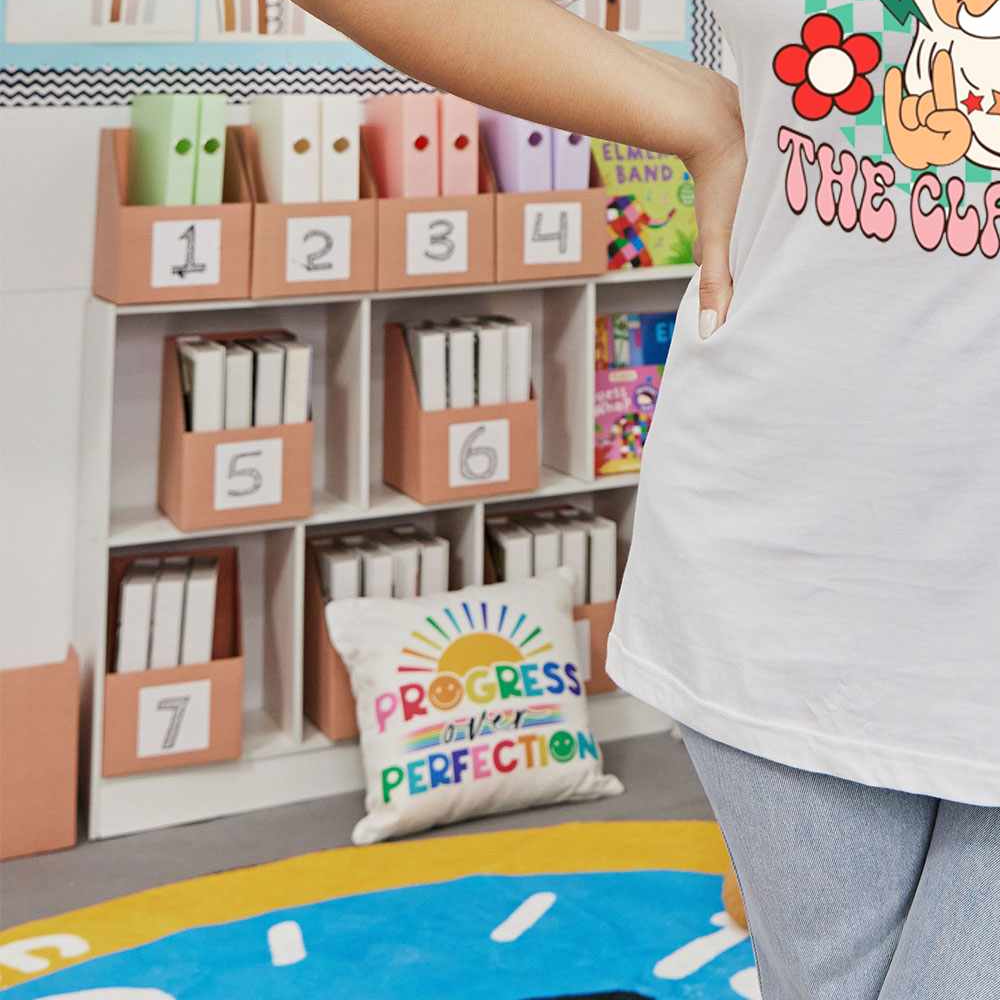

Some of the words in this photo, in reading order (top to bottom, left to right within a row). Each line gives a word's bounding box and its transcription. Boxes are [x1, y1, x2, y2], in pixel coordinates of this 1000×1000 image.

[616, 164, 673, 185] BAND
[777, 126, 897, 242] THE
[171, 223, 207, 279] 1
[302, 229, 334, 272] 2
[424, 218, 456, 262] 3
[531, 210, 569, 254] 4
[226, 449, 264, 498] 5
[460, 425, 499, 481] 6
[156, 694, 191, 750] 7
[374, 661, 582, 733] PROGRESS
[443, 709, 528, 745] over
[380, 729, 599, 804] PERFECTION
